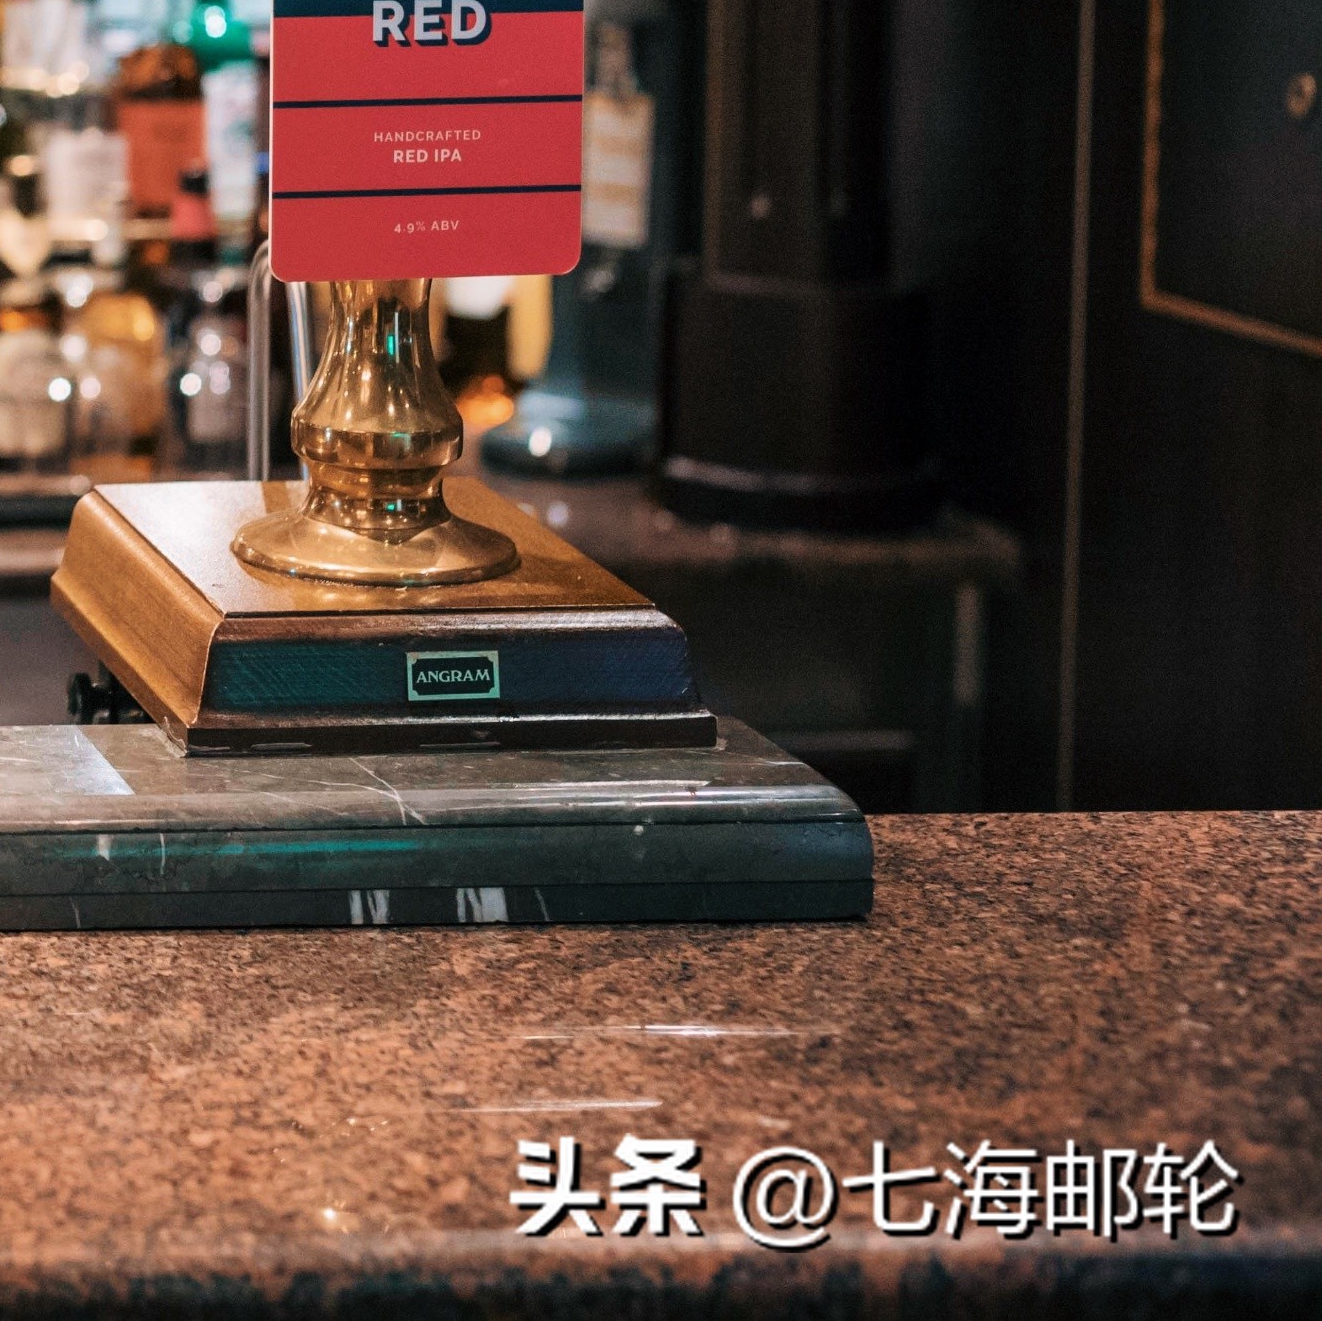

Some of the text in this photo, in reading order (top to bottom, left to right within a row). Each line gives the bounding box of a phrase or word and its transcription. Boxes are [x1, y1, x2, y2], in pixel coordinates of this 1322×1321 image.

[373, 129, 481, 143] HANDCRAFTED
[393, 148, 462, 164] RED IPA
[393, 219, 459, 234] 4.9% ABV
[415, 668, 491, 684] ANGRAM
